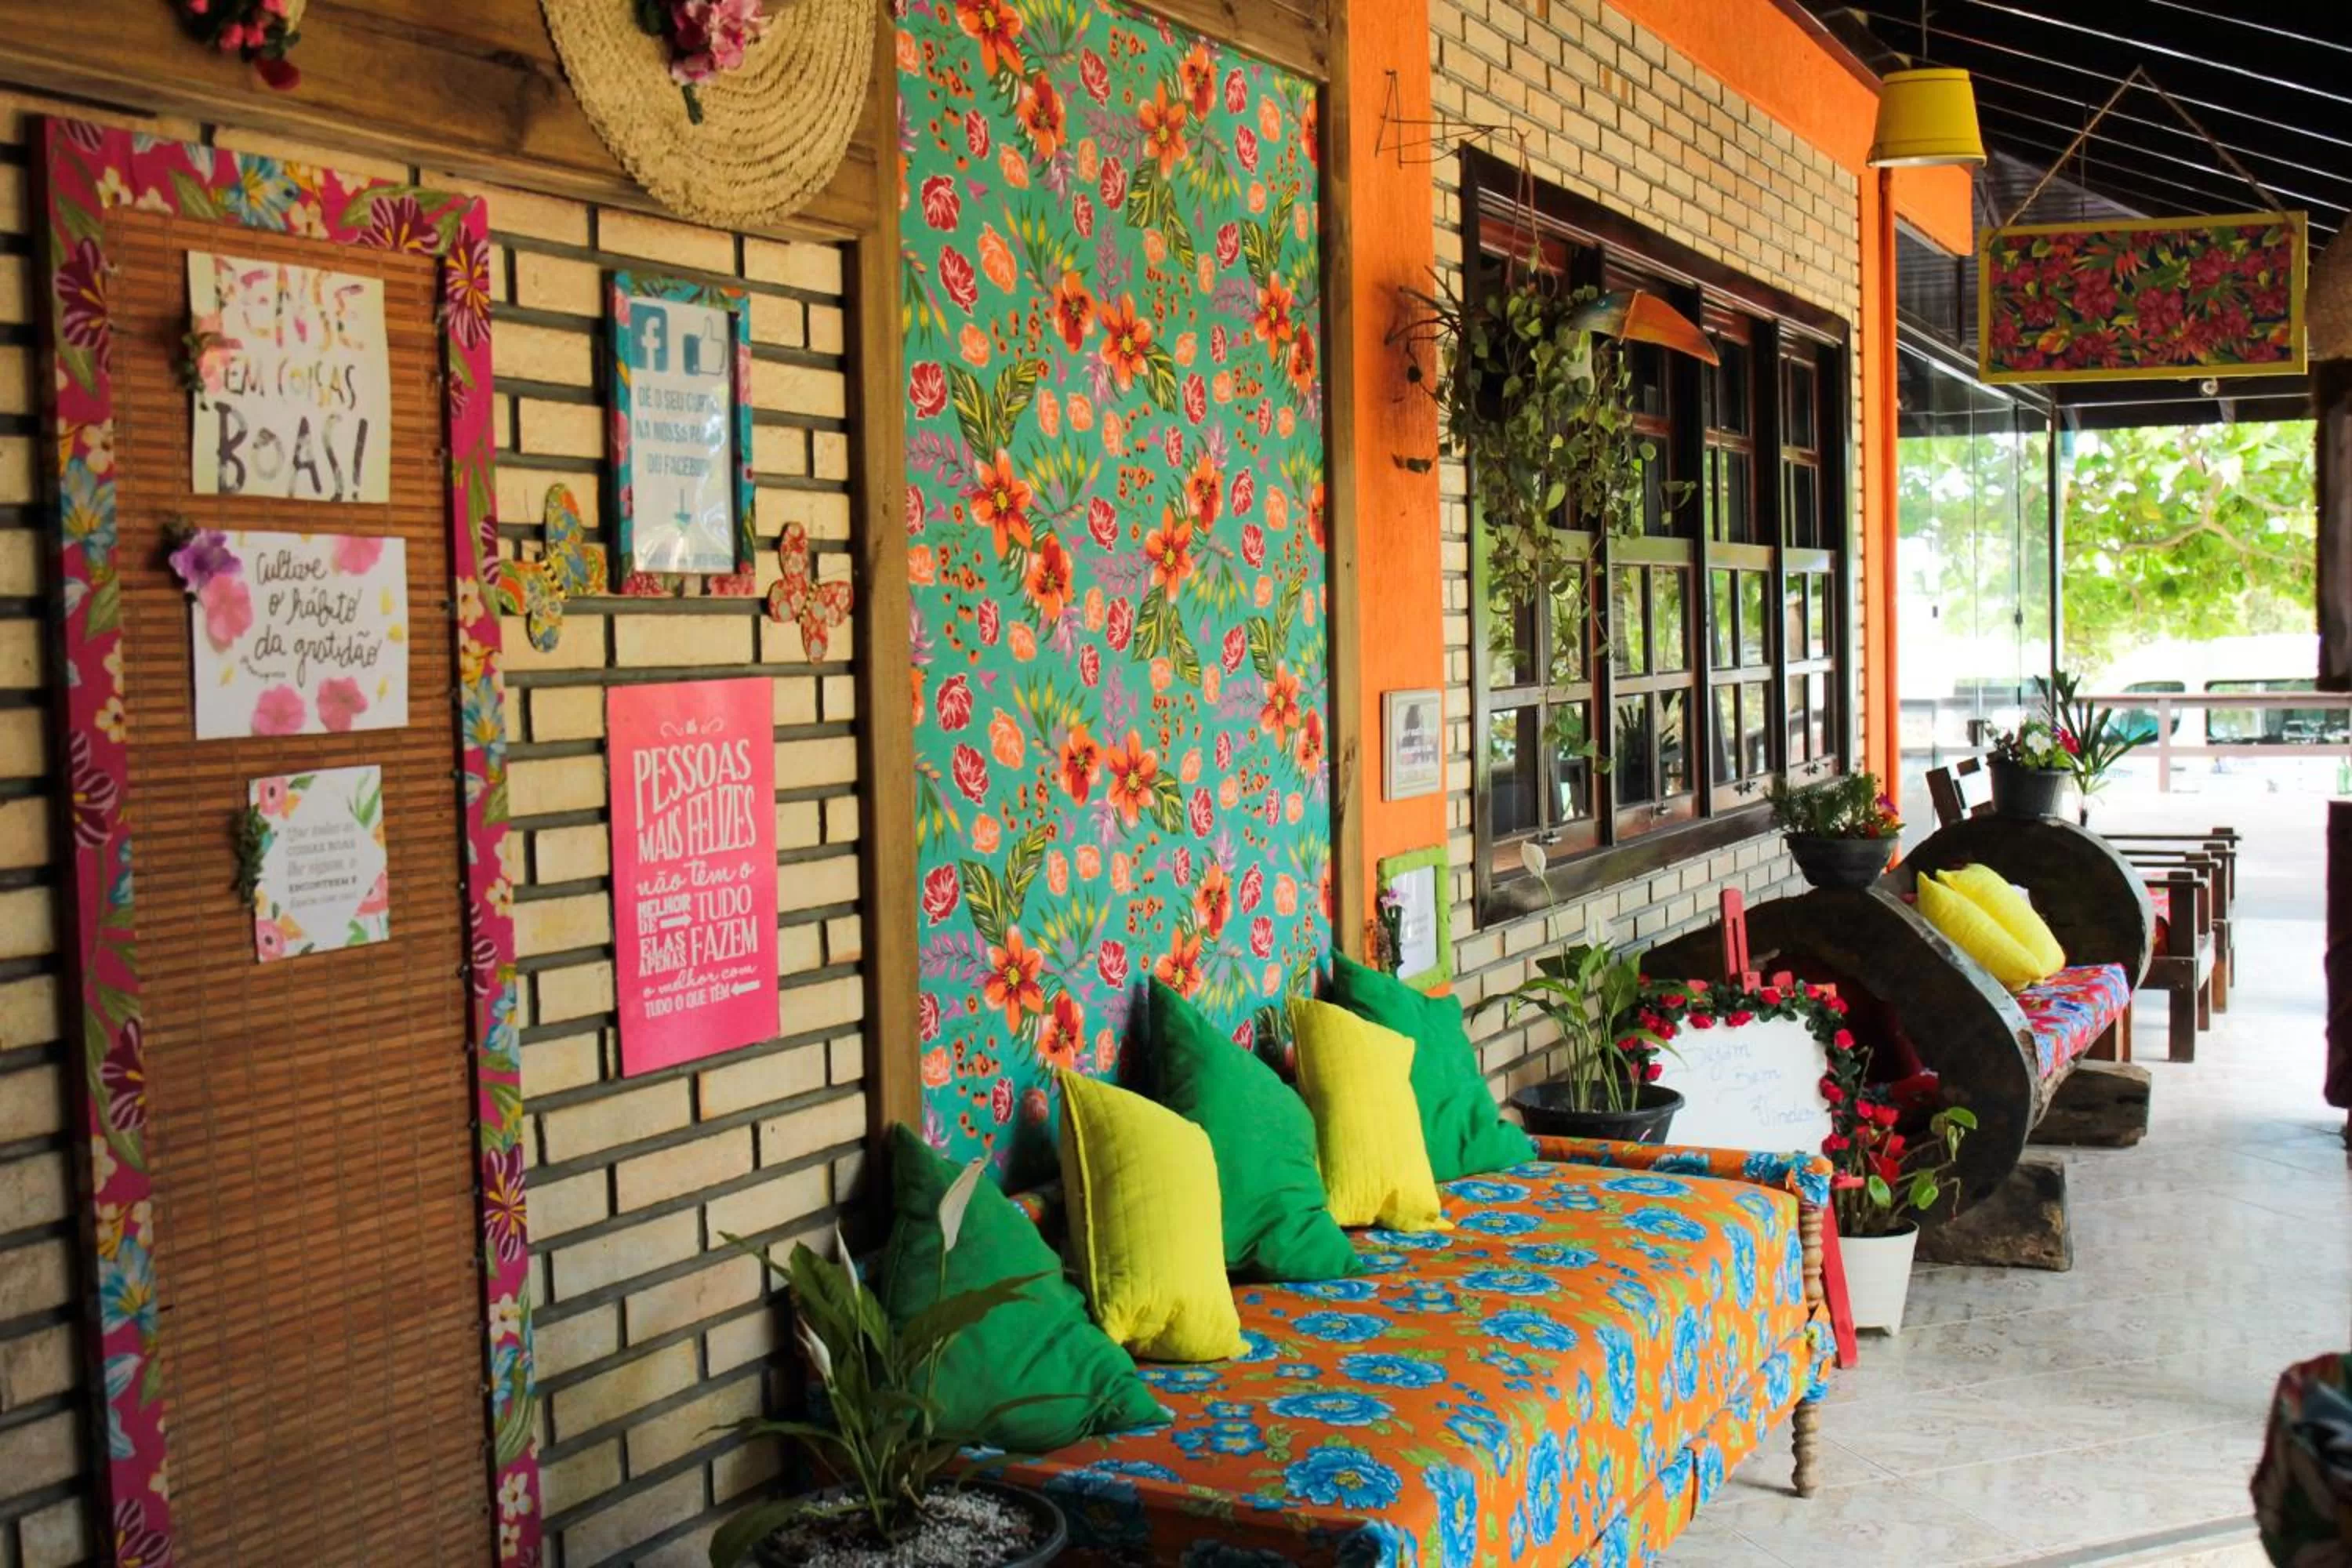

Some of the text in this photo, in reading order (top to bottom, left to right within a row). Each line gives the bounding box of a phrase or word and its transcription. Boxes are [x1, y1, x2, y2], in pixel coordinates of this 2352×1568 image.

[213, 256, 364, 351] PENSE
[225, 357, 356, 410] EM COISAS
[665, 389, 684, 411] SEU
[686, 392, 720, 413] CURT
[214, 401, 368, 502] BOAS!
[269, 590, 285, 615] o
[254, 624, 288, 661] da
[293, 630, 383, 688] gratidão
[633, 739, 752, 829] PESSOAS
[638, 785, 757, 866] MAIS FELIZES
[636, 869, 687, 895] não
[739, 860, 757, 880] o
[637, 884, 753, 922] MELHOR TUDO
[638, 916, 658, 937] DE
[640, 915, 758, 966] ELAS FAZEM
[639, 949, 687, 979] APENAS
[657, 967, 719, 994] melhor
[721, 964, 757, 981] com
[644, 996, 673, 1019] TUDO
[674, 993, 684, 1012] O
[685, 988, 708, 1009] QUE
